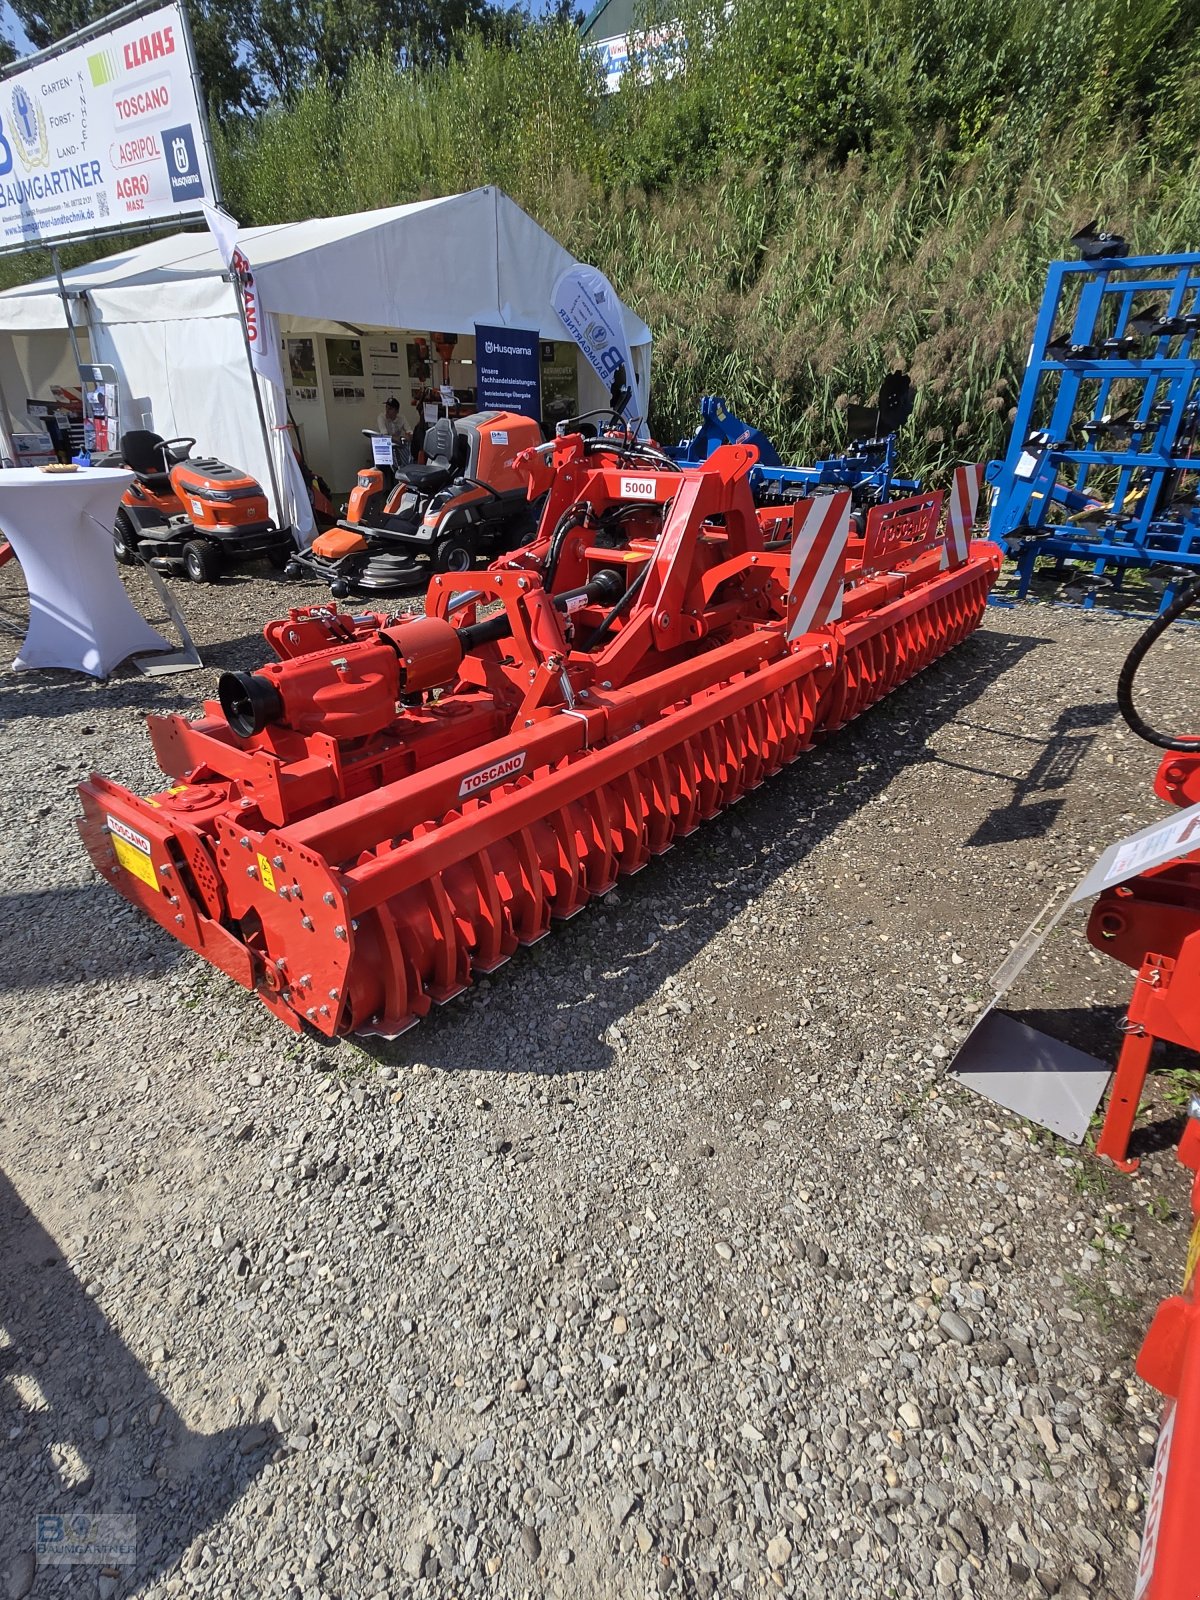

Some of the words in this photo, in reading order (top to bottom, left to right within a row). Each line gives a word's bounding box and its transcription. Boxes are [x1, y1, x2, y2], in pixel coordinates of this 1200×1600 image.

[123, 26, 175, 70] CLAAS
[115, 85, 169, 120] TOSCANO
[119, 135, 161, 164] AGRIPOL
[171, 173, 200, 188] Husqvarna
[125, 198, 145, 212] MASZ
[493, 343, 532, 356] Husqvarna
[481, 367, 499, 375] Unsere
[625, 482, 652, 494] 5000
[464, 757, 522, 791] TOSCANO
[109, 818, 148, 851] TOSCANO
